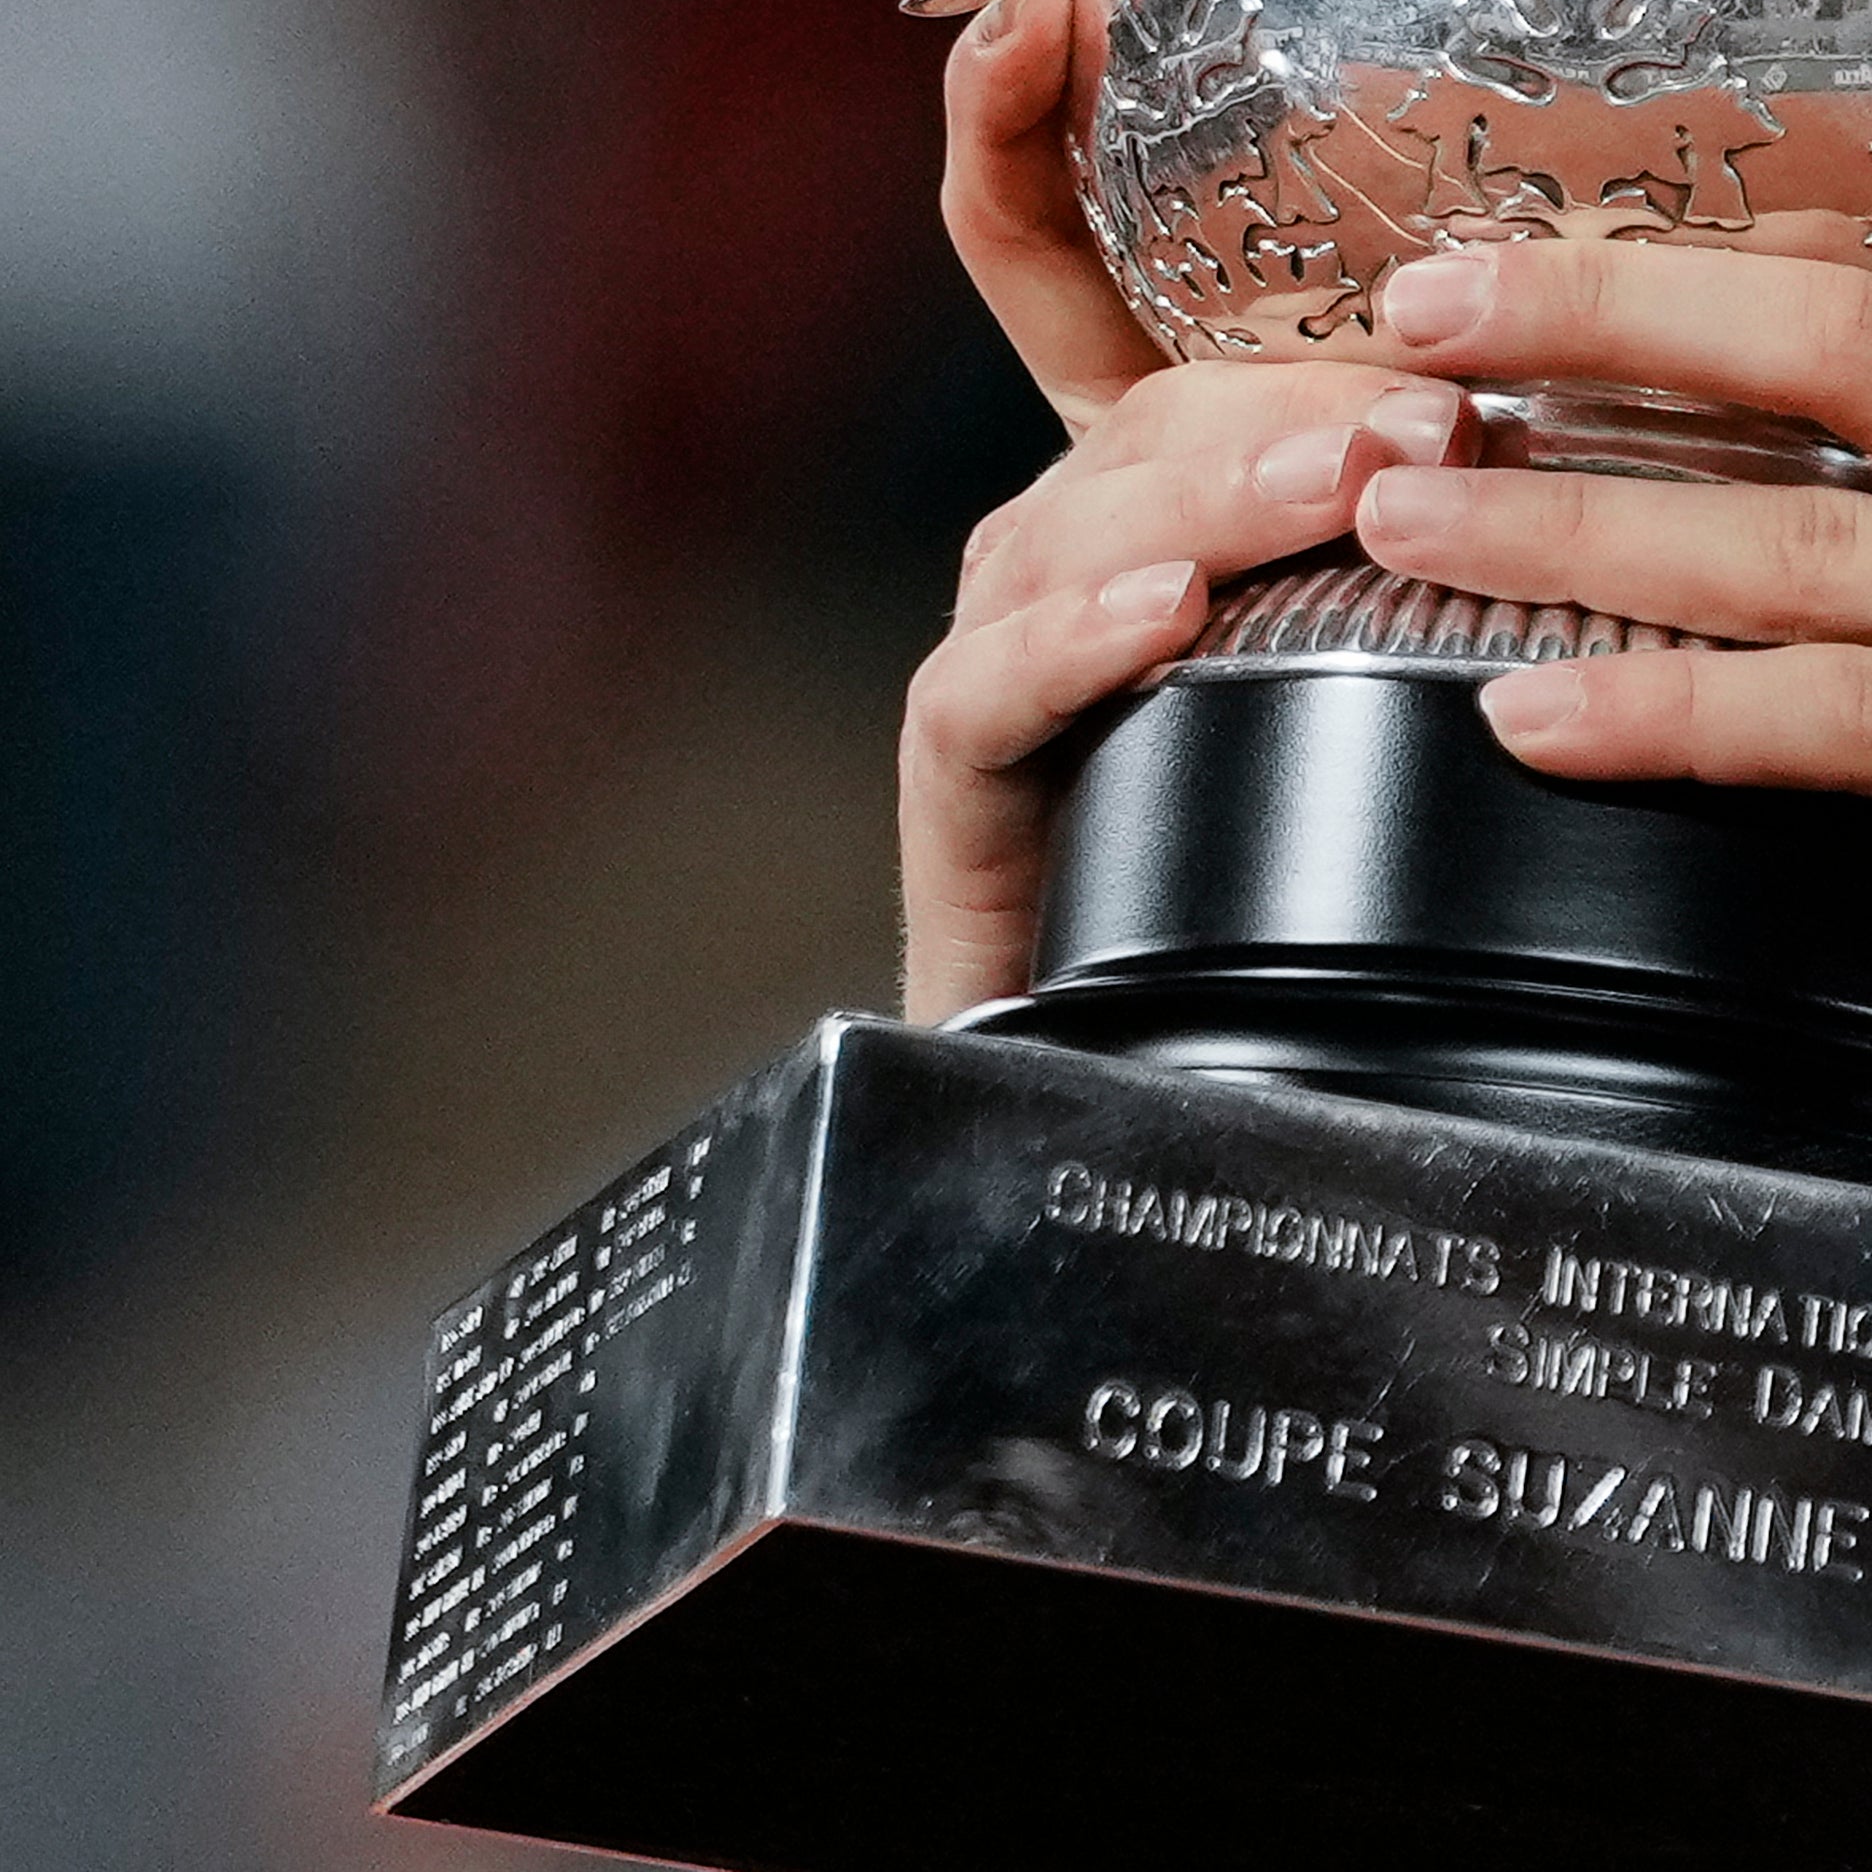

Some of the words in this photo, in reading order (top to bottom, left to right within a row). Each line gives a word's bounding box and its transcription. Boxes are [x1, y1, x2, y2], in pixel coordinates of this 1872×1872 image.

[1046, 1160, 1500, 1296] CHAMPIONNATS
[1486, 1323, 1717, 1420] SIMPLE
[1084, 1378, 1384, 1503] COUPE
[1442, 1438, 1870, 1582] SUZANNE
